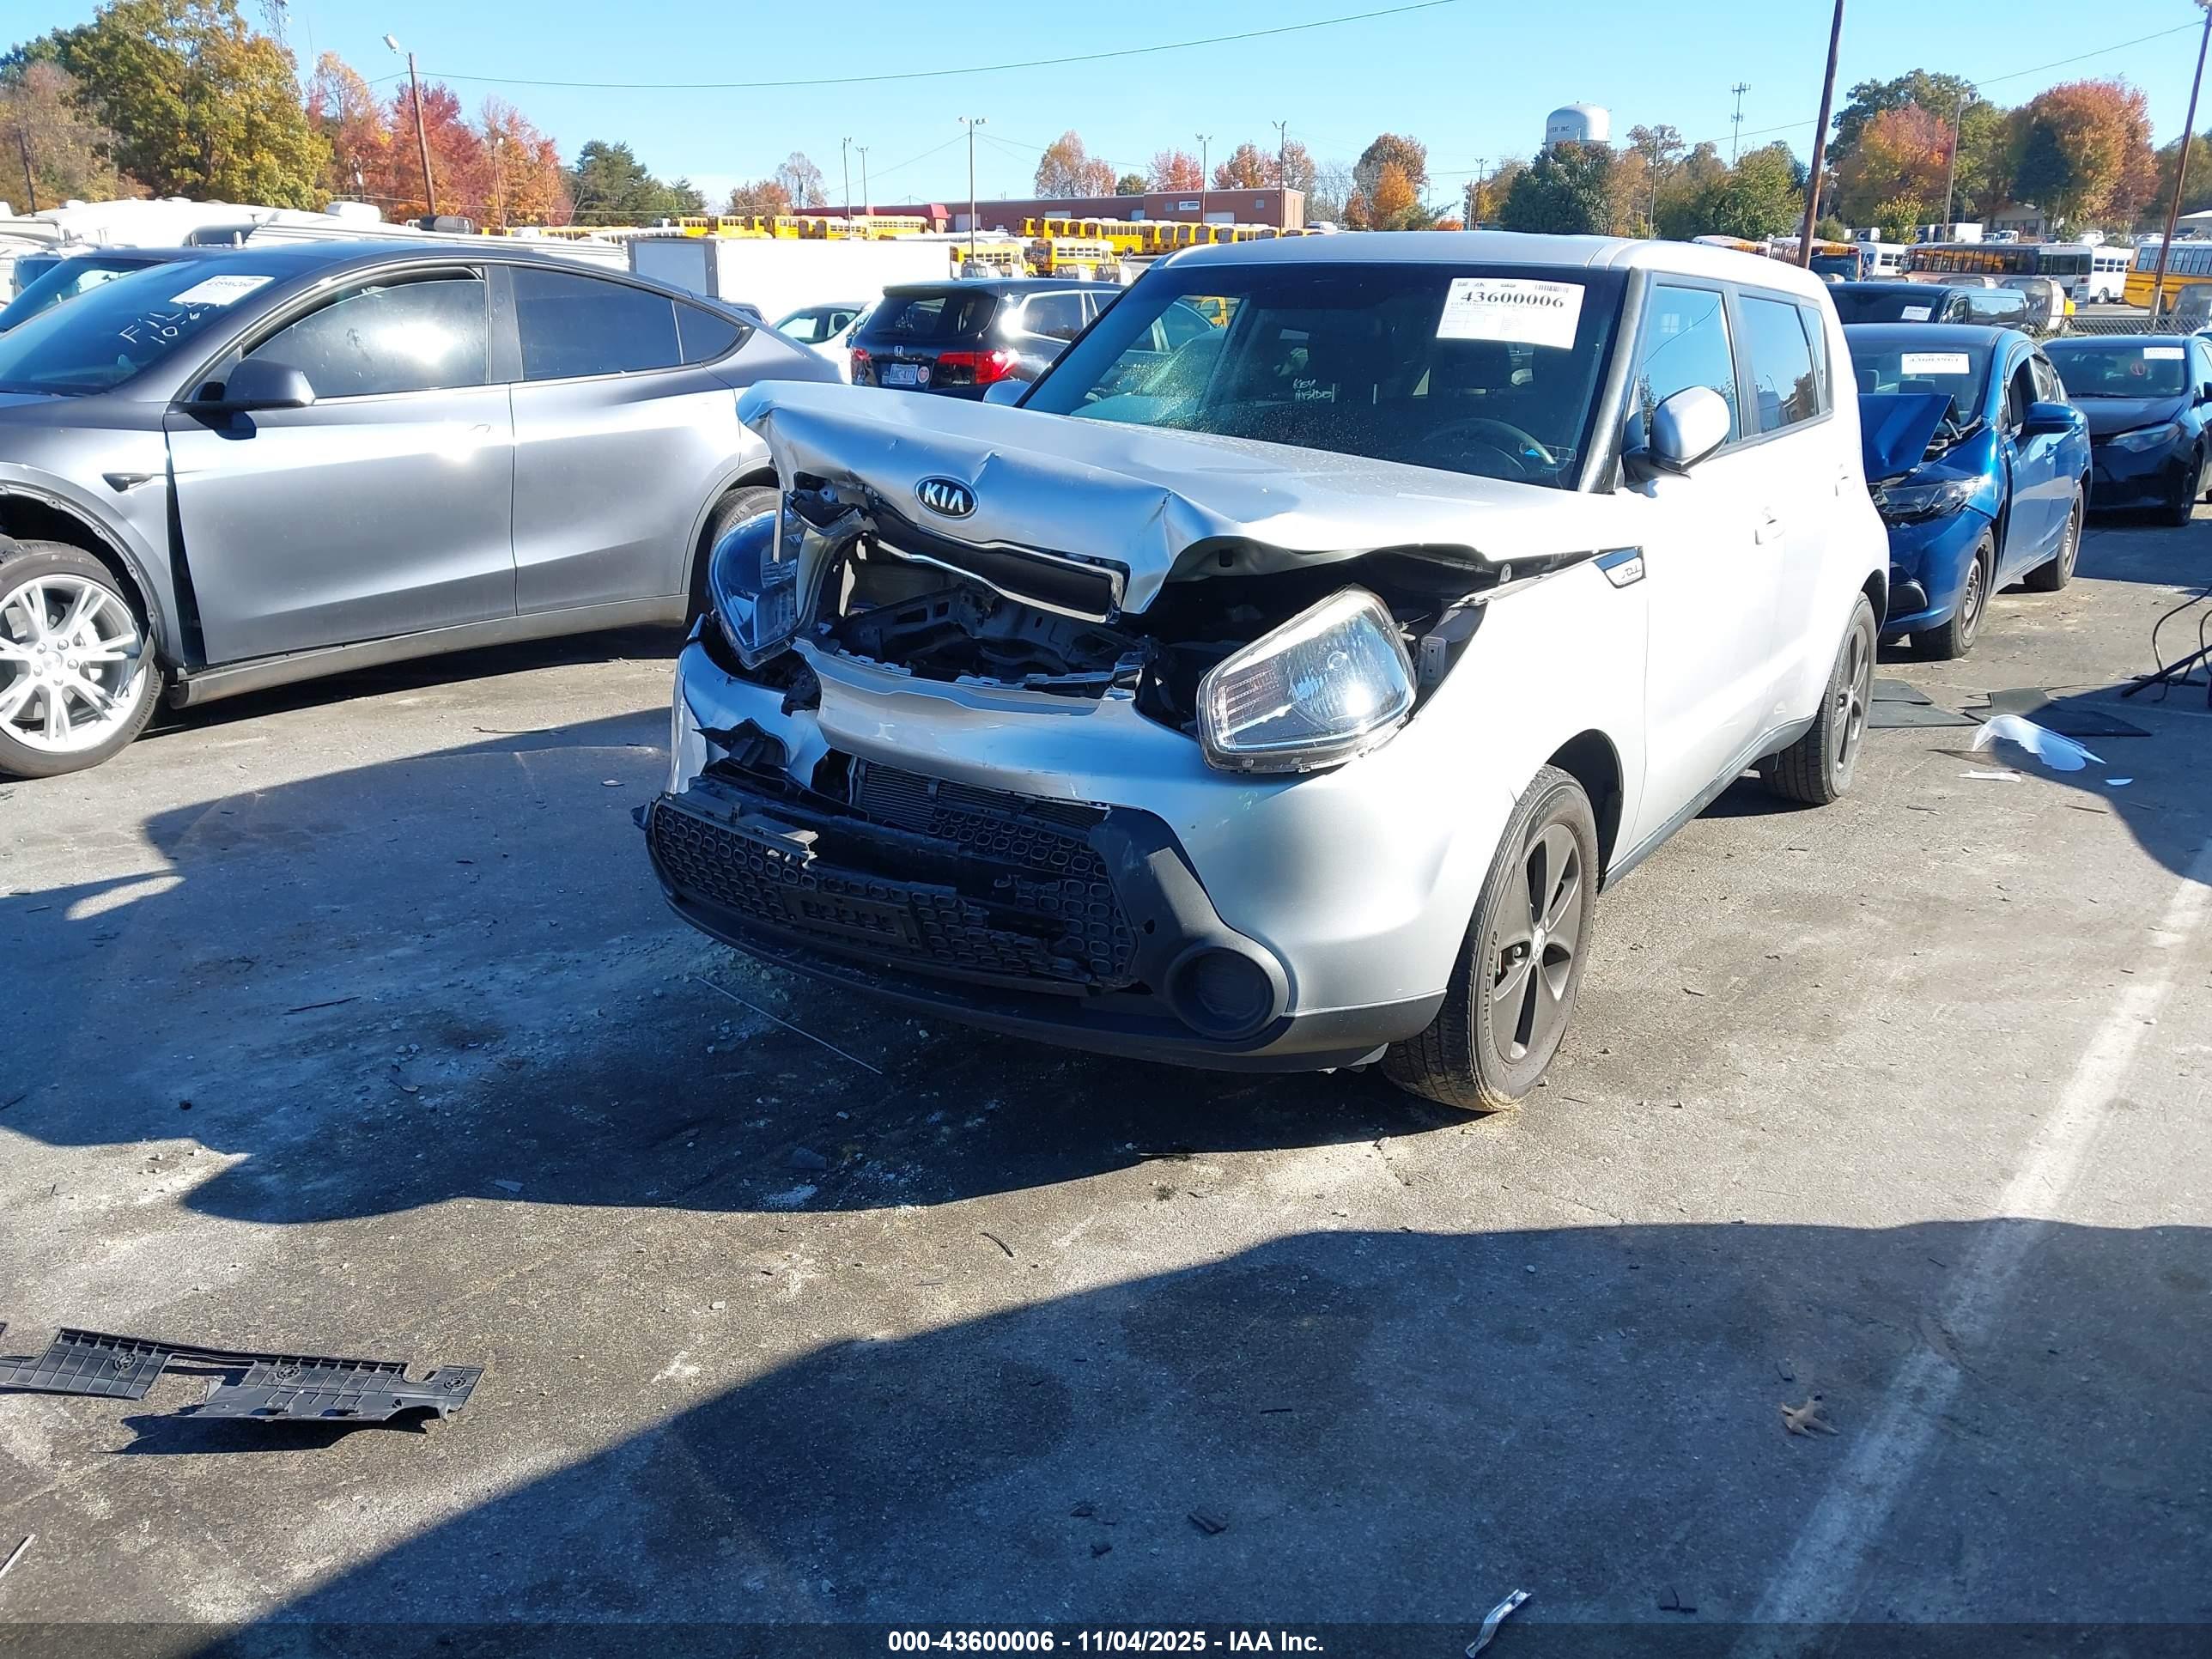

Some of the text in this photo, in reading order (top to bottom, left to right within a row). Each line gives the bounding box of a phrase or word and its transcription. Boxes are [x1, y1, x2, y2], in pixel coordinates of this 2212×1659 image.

[1461, 290, 1565, 308] 43600006
[1292, 378, 1316, 392] KEY
[924, 481, 965, 514] KIA
[1483, 930, 1498, 1022] HUGGER
